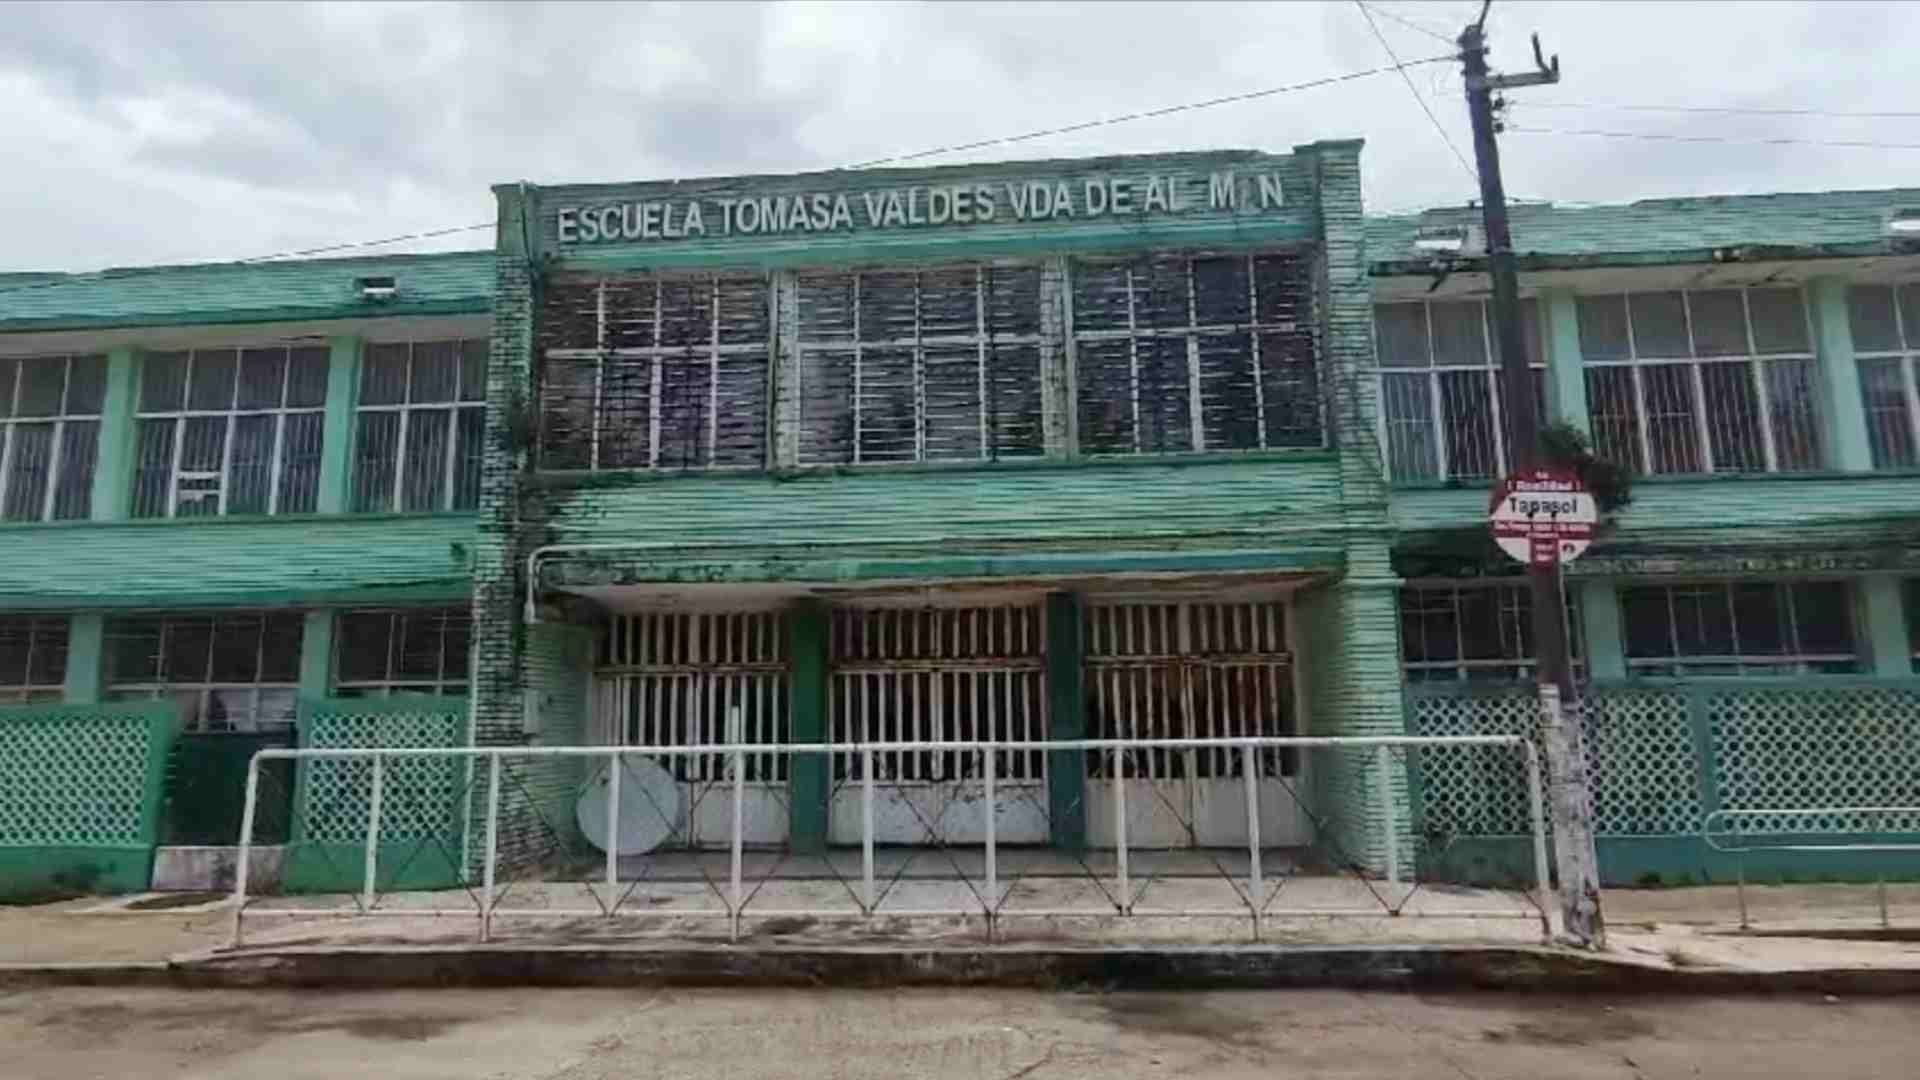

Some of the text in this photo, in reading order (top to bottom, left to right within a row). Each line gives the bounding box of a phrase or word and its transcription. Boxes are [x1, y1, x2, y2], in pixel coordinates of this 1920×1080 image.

[557, 200, 706, 243] ESCUELA
[719, 193, 853, 236] TOMASA
[863, 184, 996, 228] VALDES
[1006, 180, 1073, 220] VDA
[1085, 179, 1132, 214] DE
[1509, 497, 1577, 515] Tapasol
